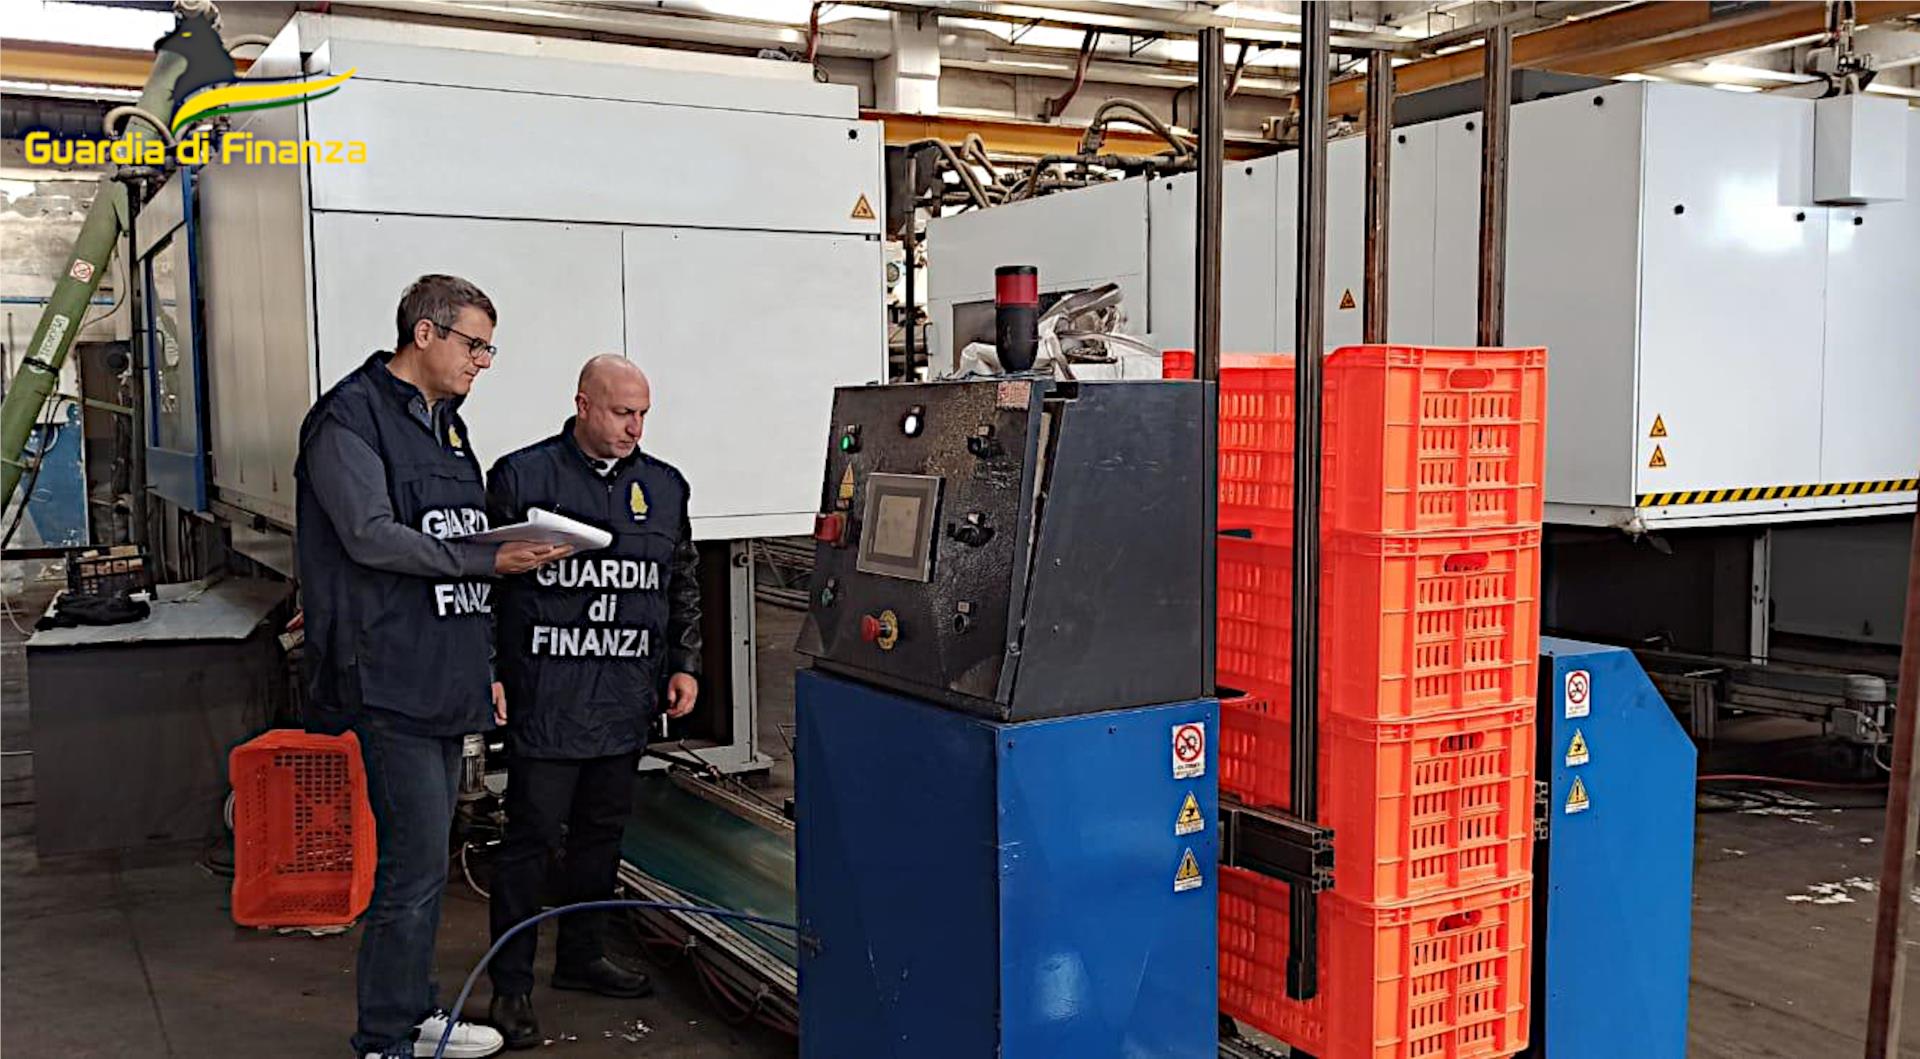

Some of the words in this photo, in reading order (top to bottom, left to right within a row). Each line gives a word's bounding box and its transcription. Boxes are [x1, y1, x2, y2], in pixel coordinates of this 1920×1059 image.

[537, 559, 659, 590] GUARDIA
[588, 594, 617, 622] di
[532, 625, 649, 657] FINANZA
